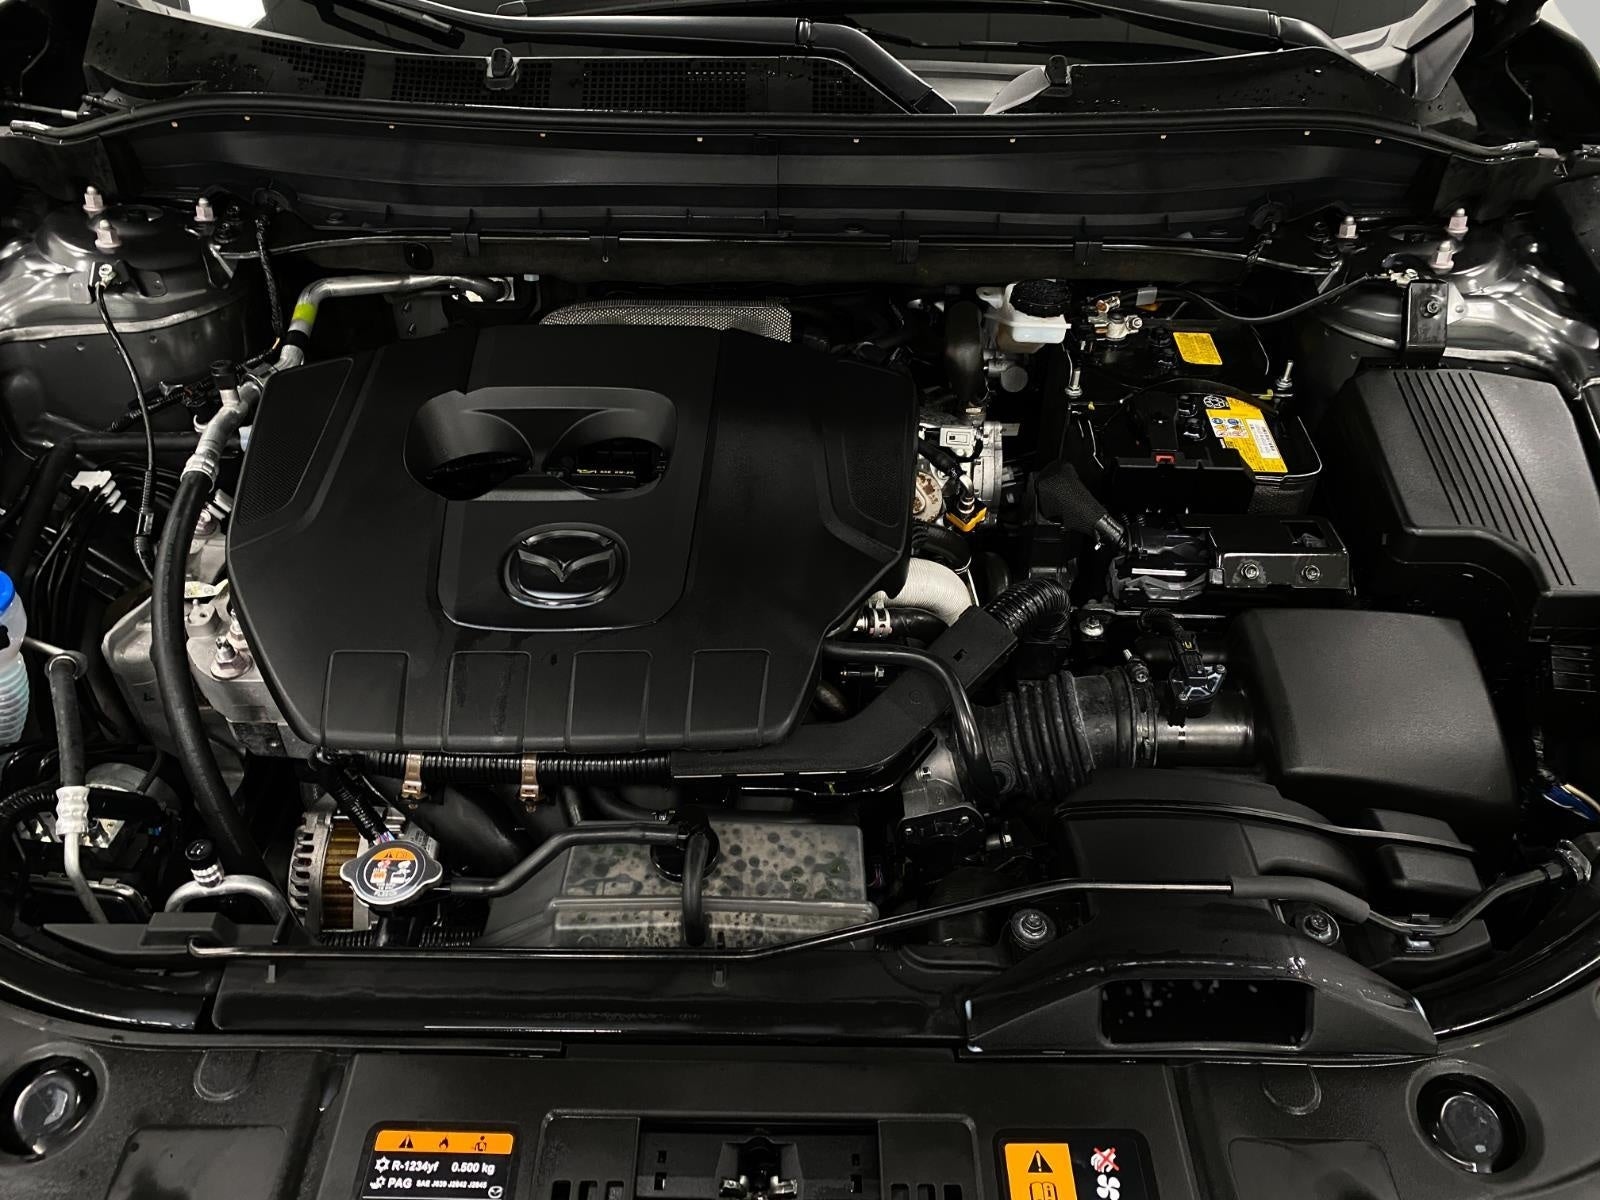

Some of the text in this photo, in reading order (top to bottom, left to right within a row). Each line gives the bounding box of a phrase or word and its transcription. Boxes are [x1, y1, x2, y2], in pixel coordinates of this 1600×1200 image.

[391, 1160, 496, 1176] R-1234yf 0.500 kg
[387, 1177, 412, 1189] PAG
